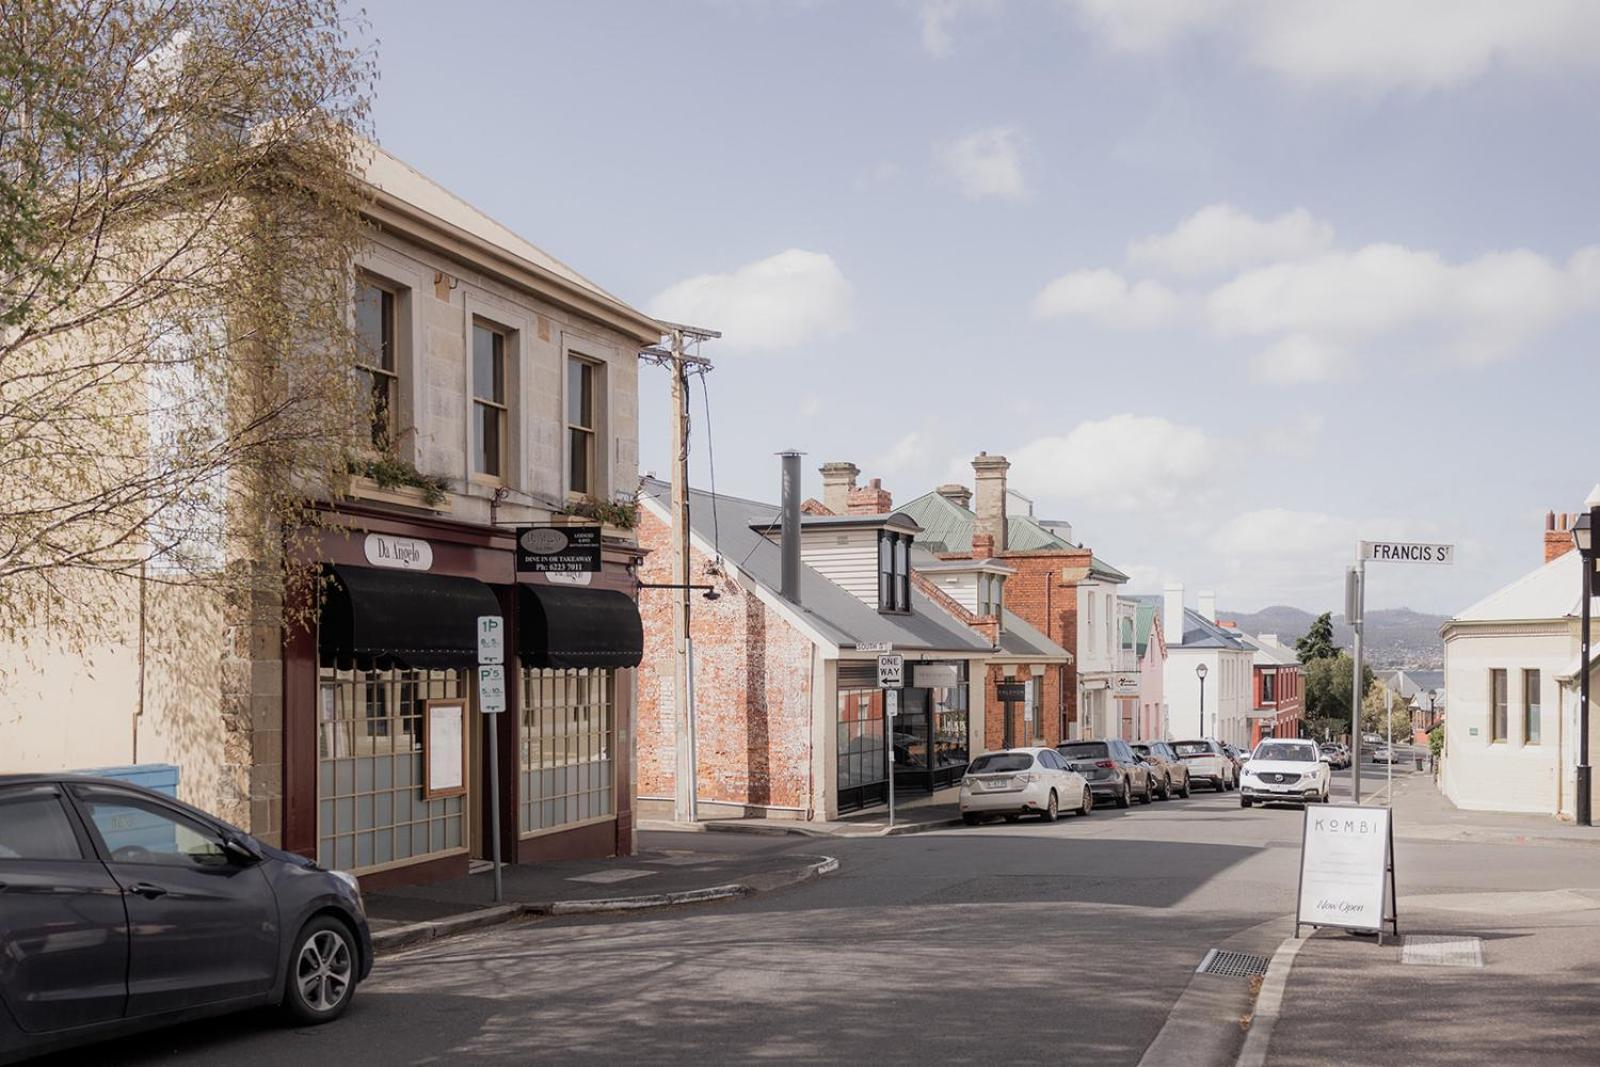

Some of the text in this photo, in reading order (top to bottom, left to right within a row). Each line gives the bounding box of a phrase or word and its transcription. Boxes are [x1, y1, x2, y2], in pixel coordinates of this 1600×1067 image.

[377, 537, 420, 567] Da Angelo
[1373, 544, 1432, 561] FRANCIS
[525, 555, 593, 563] DINE IN OR TAKEAWAY
[856, 640, 878, 650] SOUTH
[881, 657, 899, 666] ONE
[880, 668, 900, 676] WAY
[1314, 818, 1377, 834] KOMBI
[1316, 899, 1364, 913] Now Open
